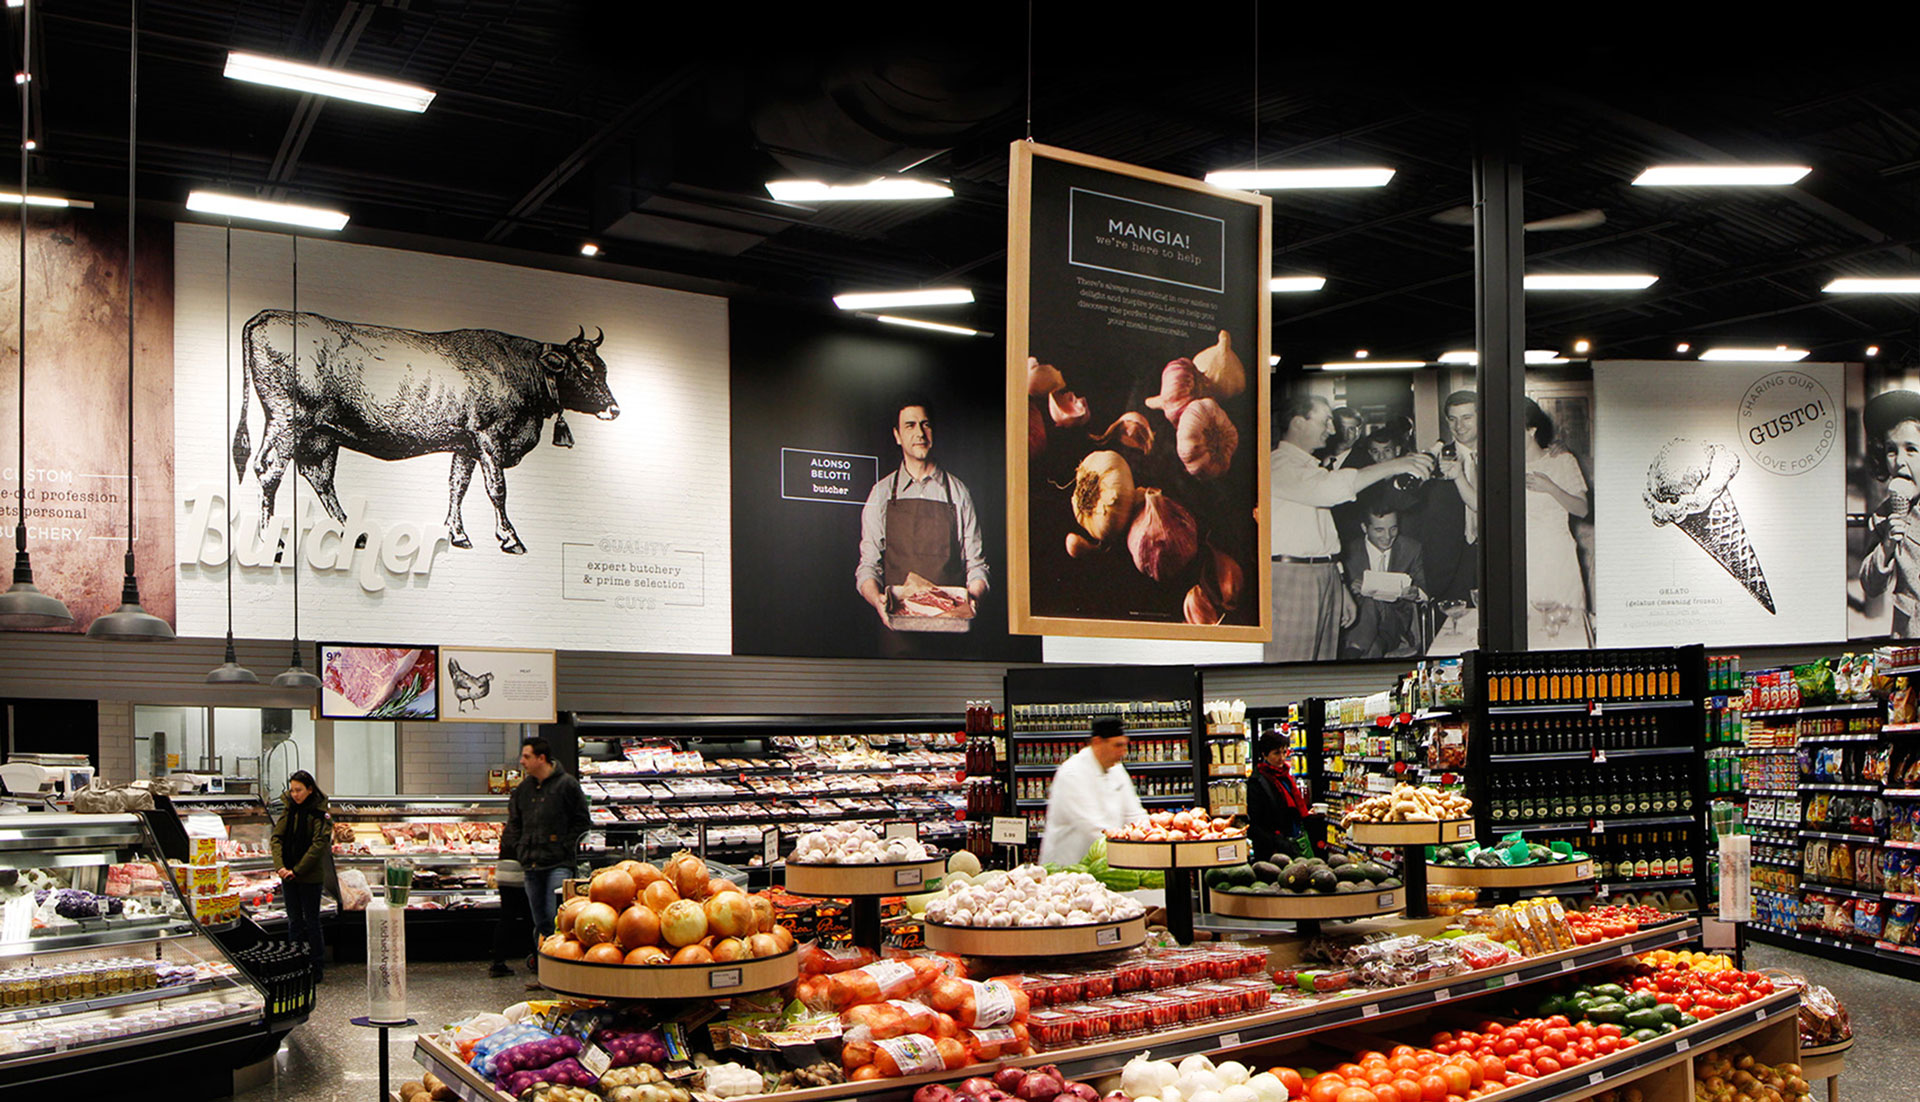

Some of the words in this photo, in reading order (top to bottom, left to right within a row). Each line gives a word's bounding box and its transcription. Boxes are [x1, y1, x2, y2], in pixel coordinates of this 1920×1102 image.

[1108, 218, 1190, 249] MANGIA!
[1096, 235, 1129, 250] we're
[1132, 241, 1159, 256] here
[1162, 248, 1174, 259] to
[1177, 250, 1202, 266] help
[1076, 276, 1105, 289] There's
[1131, 287, 1169, 301] something
[1169, 293, 1177, 302] in
[1177, 295, 1190, 304] our
[1076, 299, 1109, 312] discover
[1110, 304, 1122, 315] the
[1122, 307, 1147, 319] perfect
[1148, 312, 1189, 327] ingredients
[1189, 320, 1198, 328] to
[1079, 288, 1106, 300] delight
[1107, 293, 1121, 303] and
[1122, 295, 1148, 307] inspire
[1164, 303, 1176, 313] Let
[1176, 305, 1186, 315] us
[1186, 307, 1201, 319] help
[1200, 311, 1215, 321] you
[1107, 316, 1126, 326] your
[1126, 320, 1148, 330] meals
[1743, 376, 1784, 417] SHARING
[1788, 376, 1814, 392] OUR
[1749, 400, 1826, 445] GUSTO!
[1756, 451, 1787, 471] LOVE
[1791, 454, 1815, 470] FOR
[1815, 420, 1834, 455] FOOD
[810, 458, 851, 470] ALONSO
[811, 469, 851, 481] BELOTTI
[41, 490, 118, 503] profession
[812, 483, 849, 495] butcher
[23, 507, 87, 519] personal
[180, 486, 450, 592] Butcher
[599, 538, 671, 556] QUALITY
[587, 561, 627, 573] expert
[629, 562, 682, 577] butchery
[583, 574, 593, 585] &
[597, 576, 631, 587] prime
[634, 577, 685, 589] selection
[614, 596, 657, 610] CUTS
